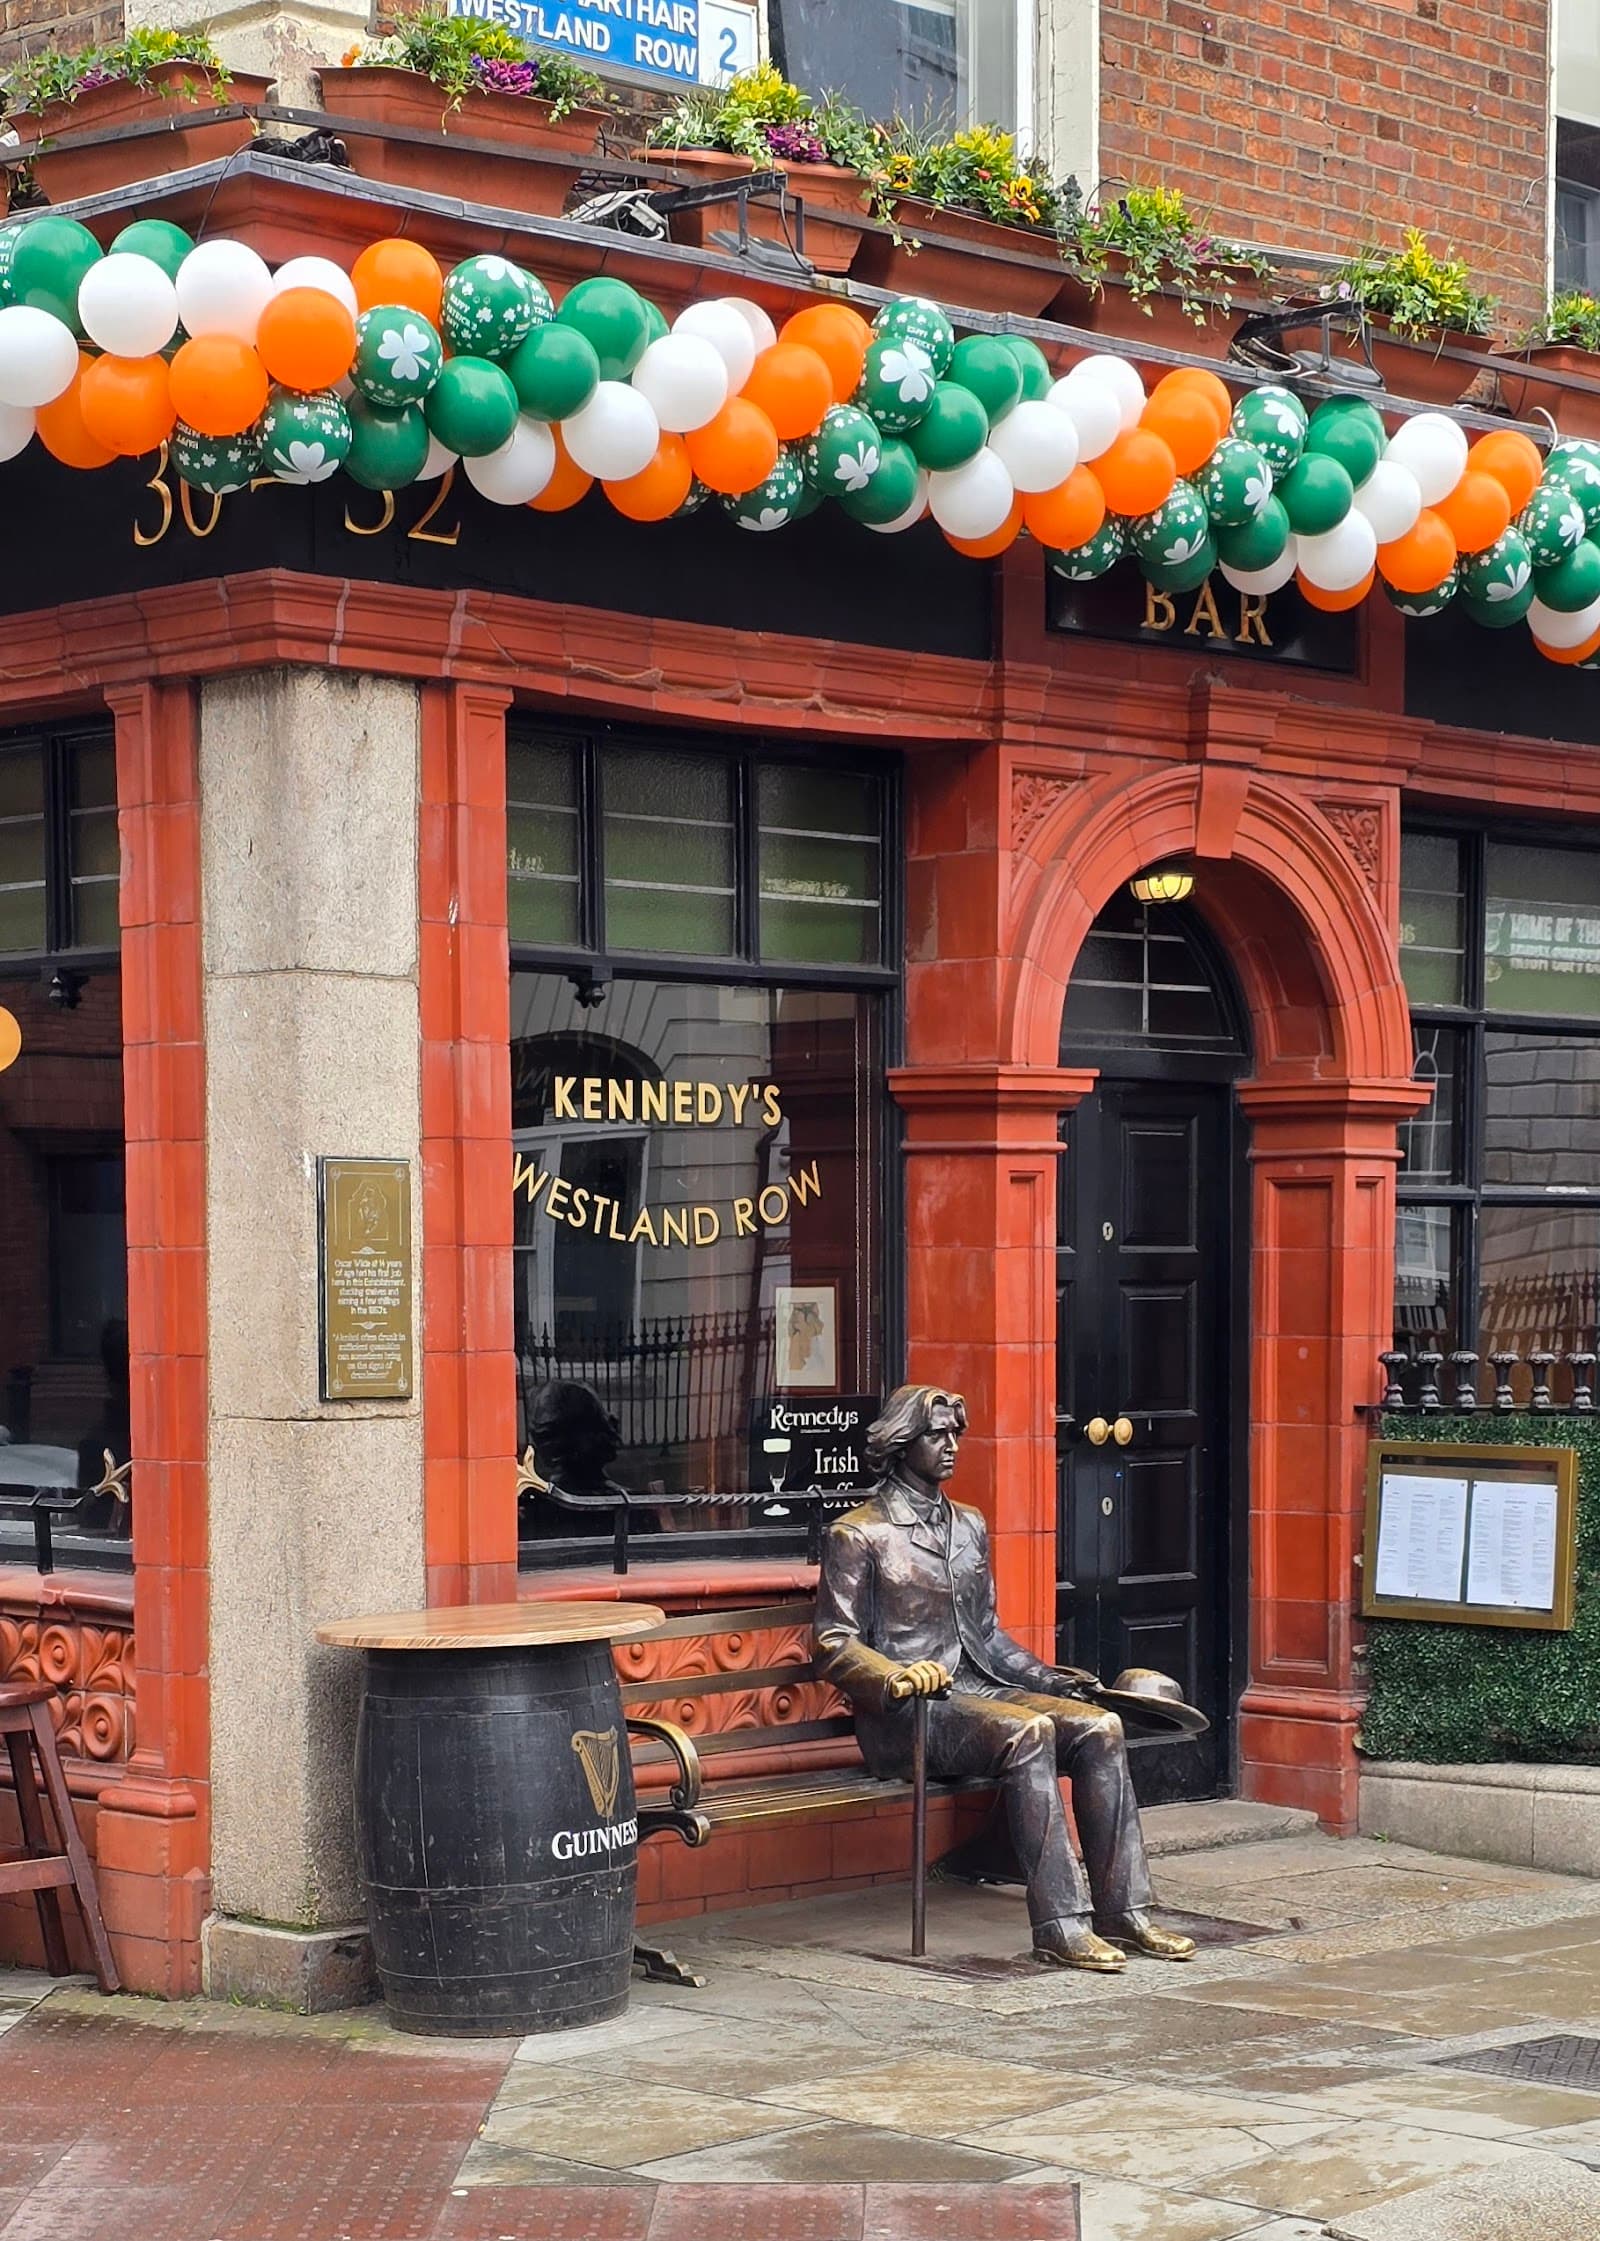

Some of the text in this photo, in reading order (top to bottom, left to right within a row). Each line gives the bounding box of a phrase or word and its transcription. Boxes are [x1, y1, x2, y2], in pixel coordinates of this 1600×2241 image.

[461, 0, 697, 76] WESTLAND ROW
[719, 27, 738, 72] 2
[1140, 578, 1274, 647] BAR
[554, 1076, 782, 1127] KENNEDY'S
[512, 1153, 822, 1247] WESTLAND ROW
[770, 1404, 859, 1433] Kennedys
[814, 1446, 859, 1475] Irish
